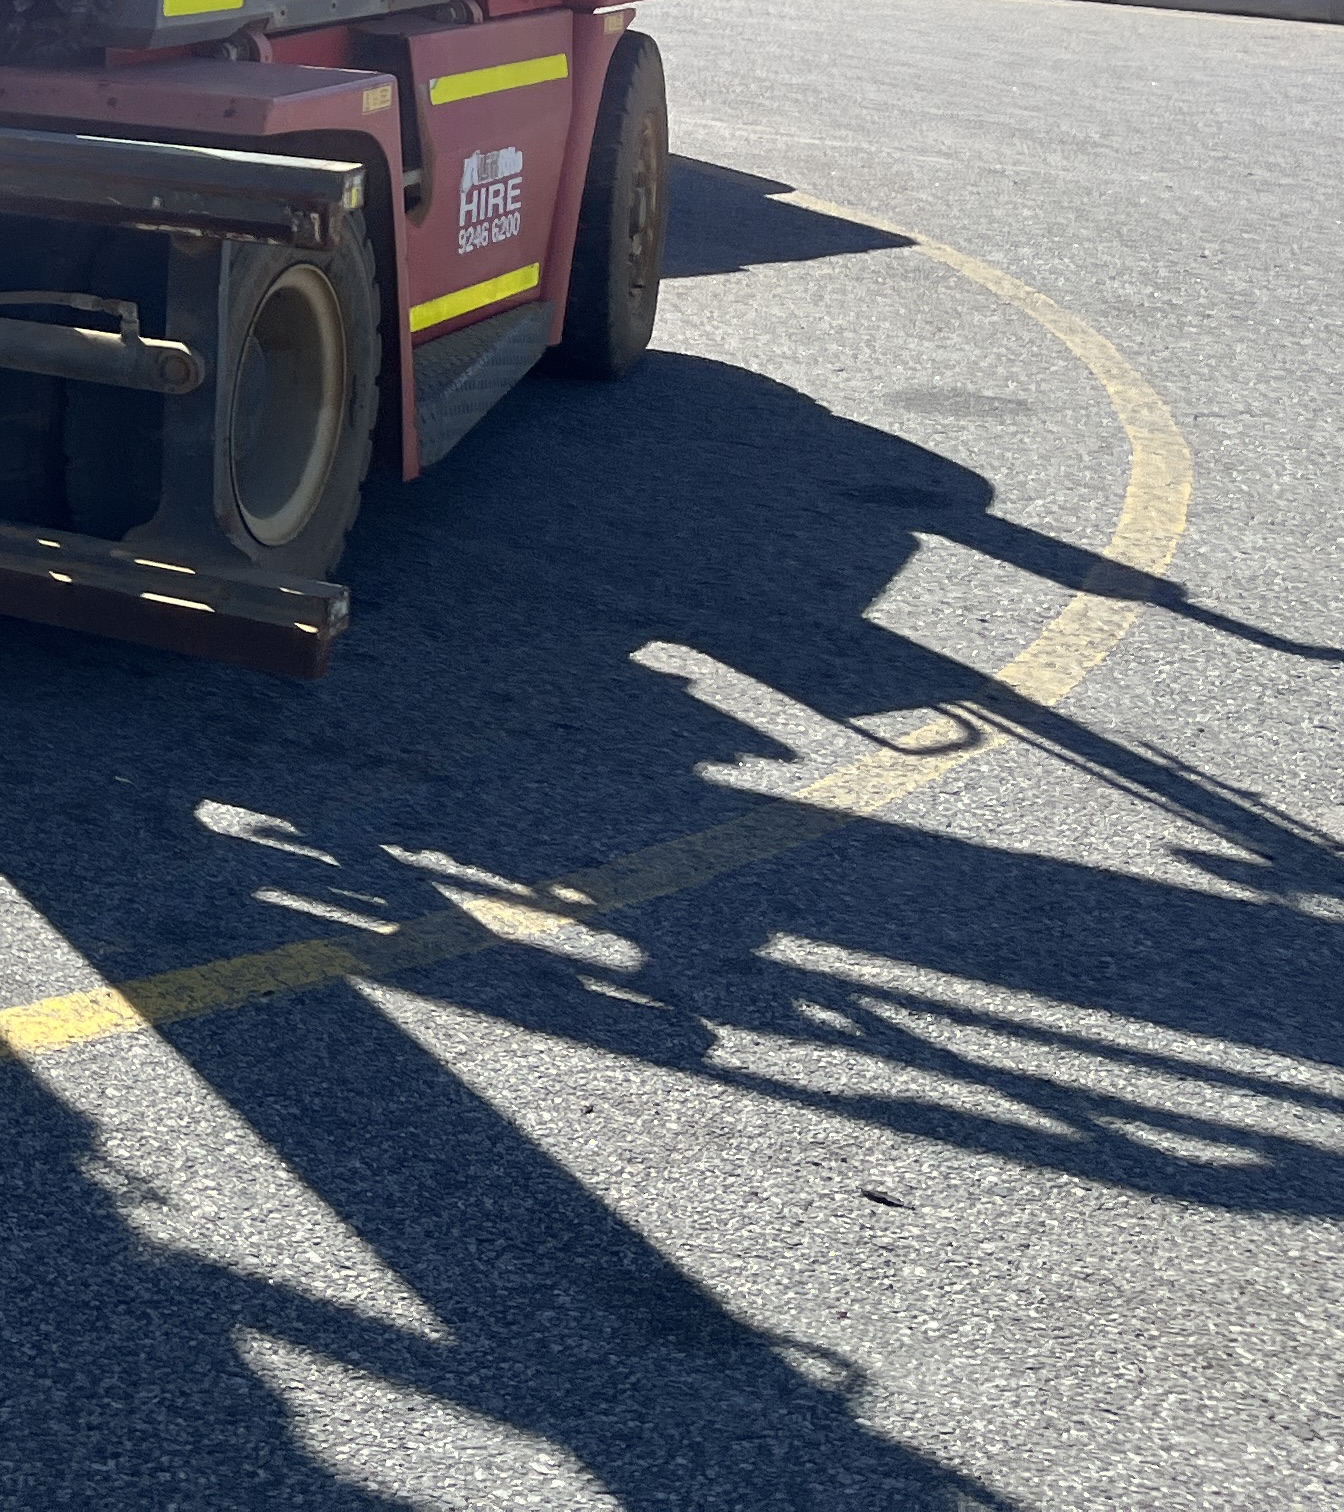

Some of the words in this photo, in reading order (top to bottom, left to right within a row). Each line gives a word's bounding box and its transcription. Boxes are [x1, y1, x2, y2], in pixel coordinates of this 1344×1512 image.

[459, 177, 522, 226] HIRE
[458, 221, 489, 255] 9246
[491, 212, 521, 243] 6200
